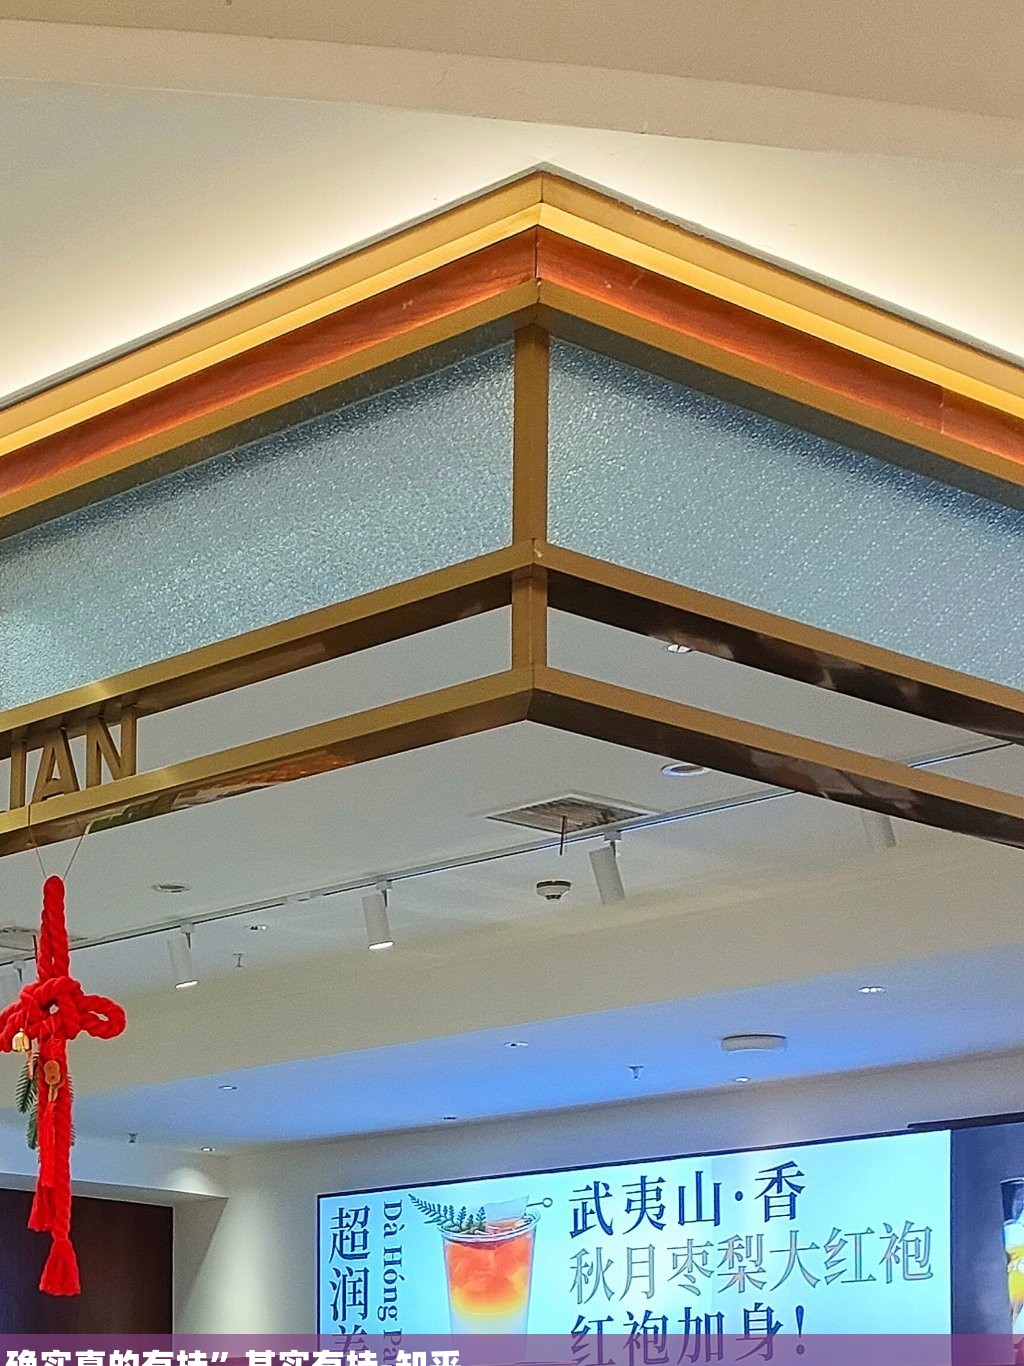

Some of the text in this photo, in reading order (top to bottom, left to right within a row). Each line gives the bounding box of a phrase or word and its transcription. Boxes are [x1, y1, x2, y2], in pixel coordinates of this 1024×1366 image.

[568, 1160, 806, 1239] 武夷山·香
[378, 1246, 405, 1321] Hóng
[569, 1220, 934, 1305] 秋月枣梨大红袍
